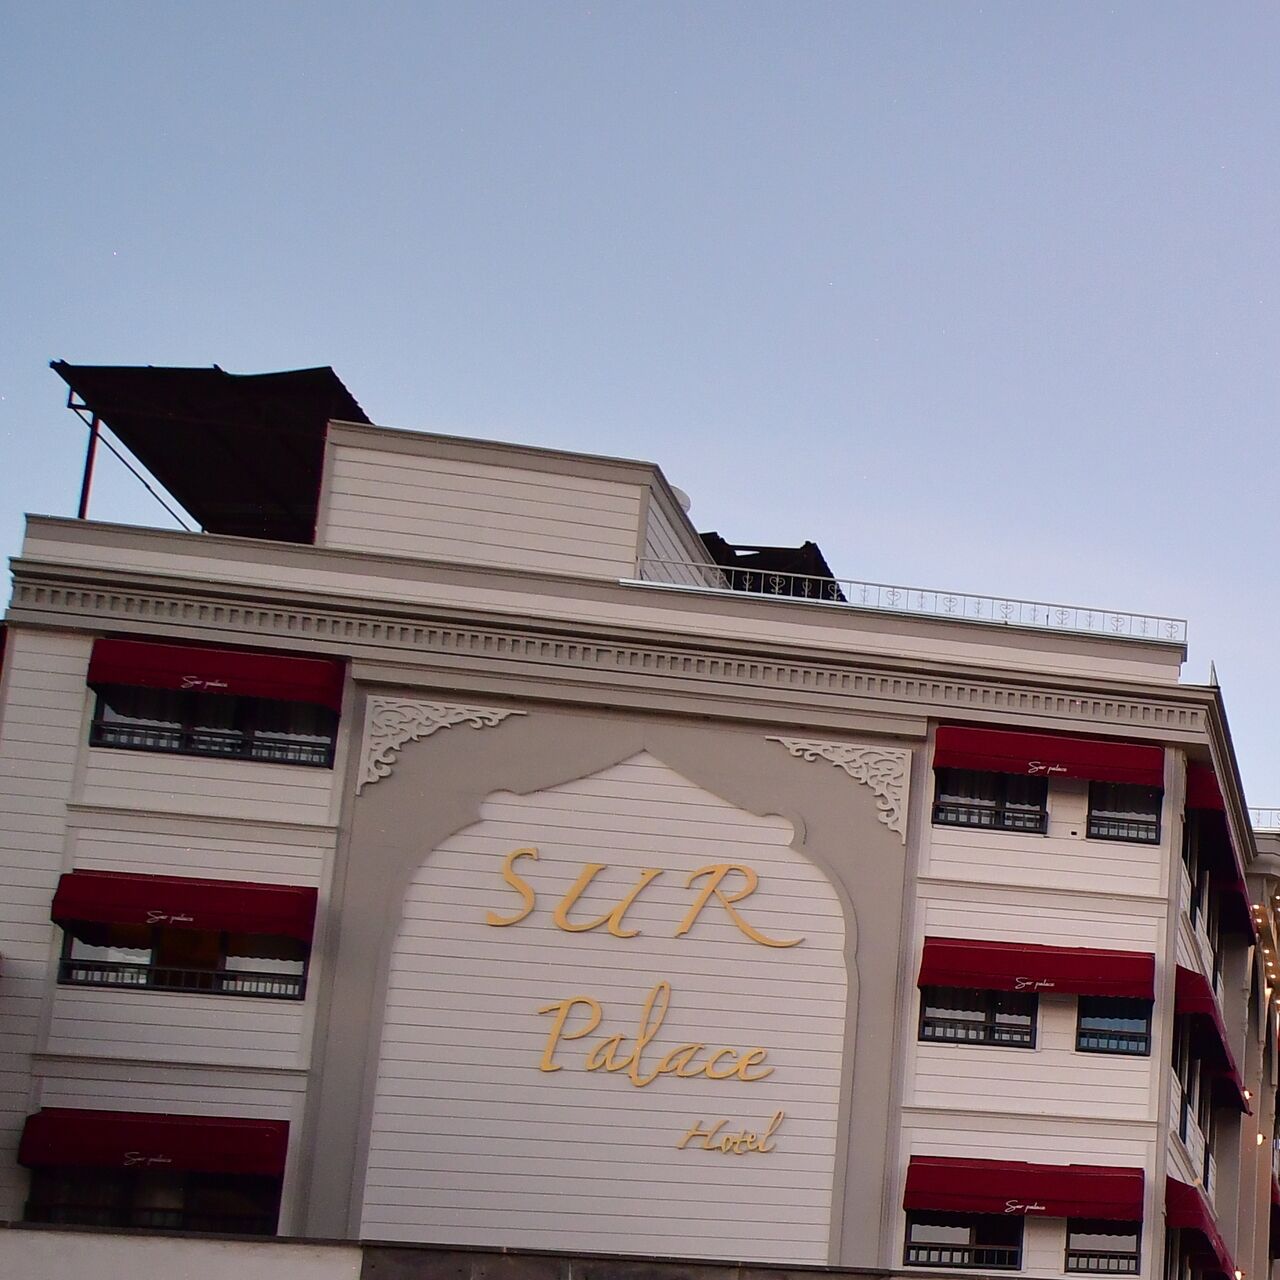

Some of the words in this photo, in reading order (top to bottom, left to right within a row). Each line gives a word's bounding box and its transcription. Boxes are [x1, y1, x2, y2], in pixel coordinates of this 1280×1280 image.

[486, 847, 806, 948] SUR
[538, 980, 775, 1087] Palace
[676, 1109, 785, 1155] Hotel
